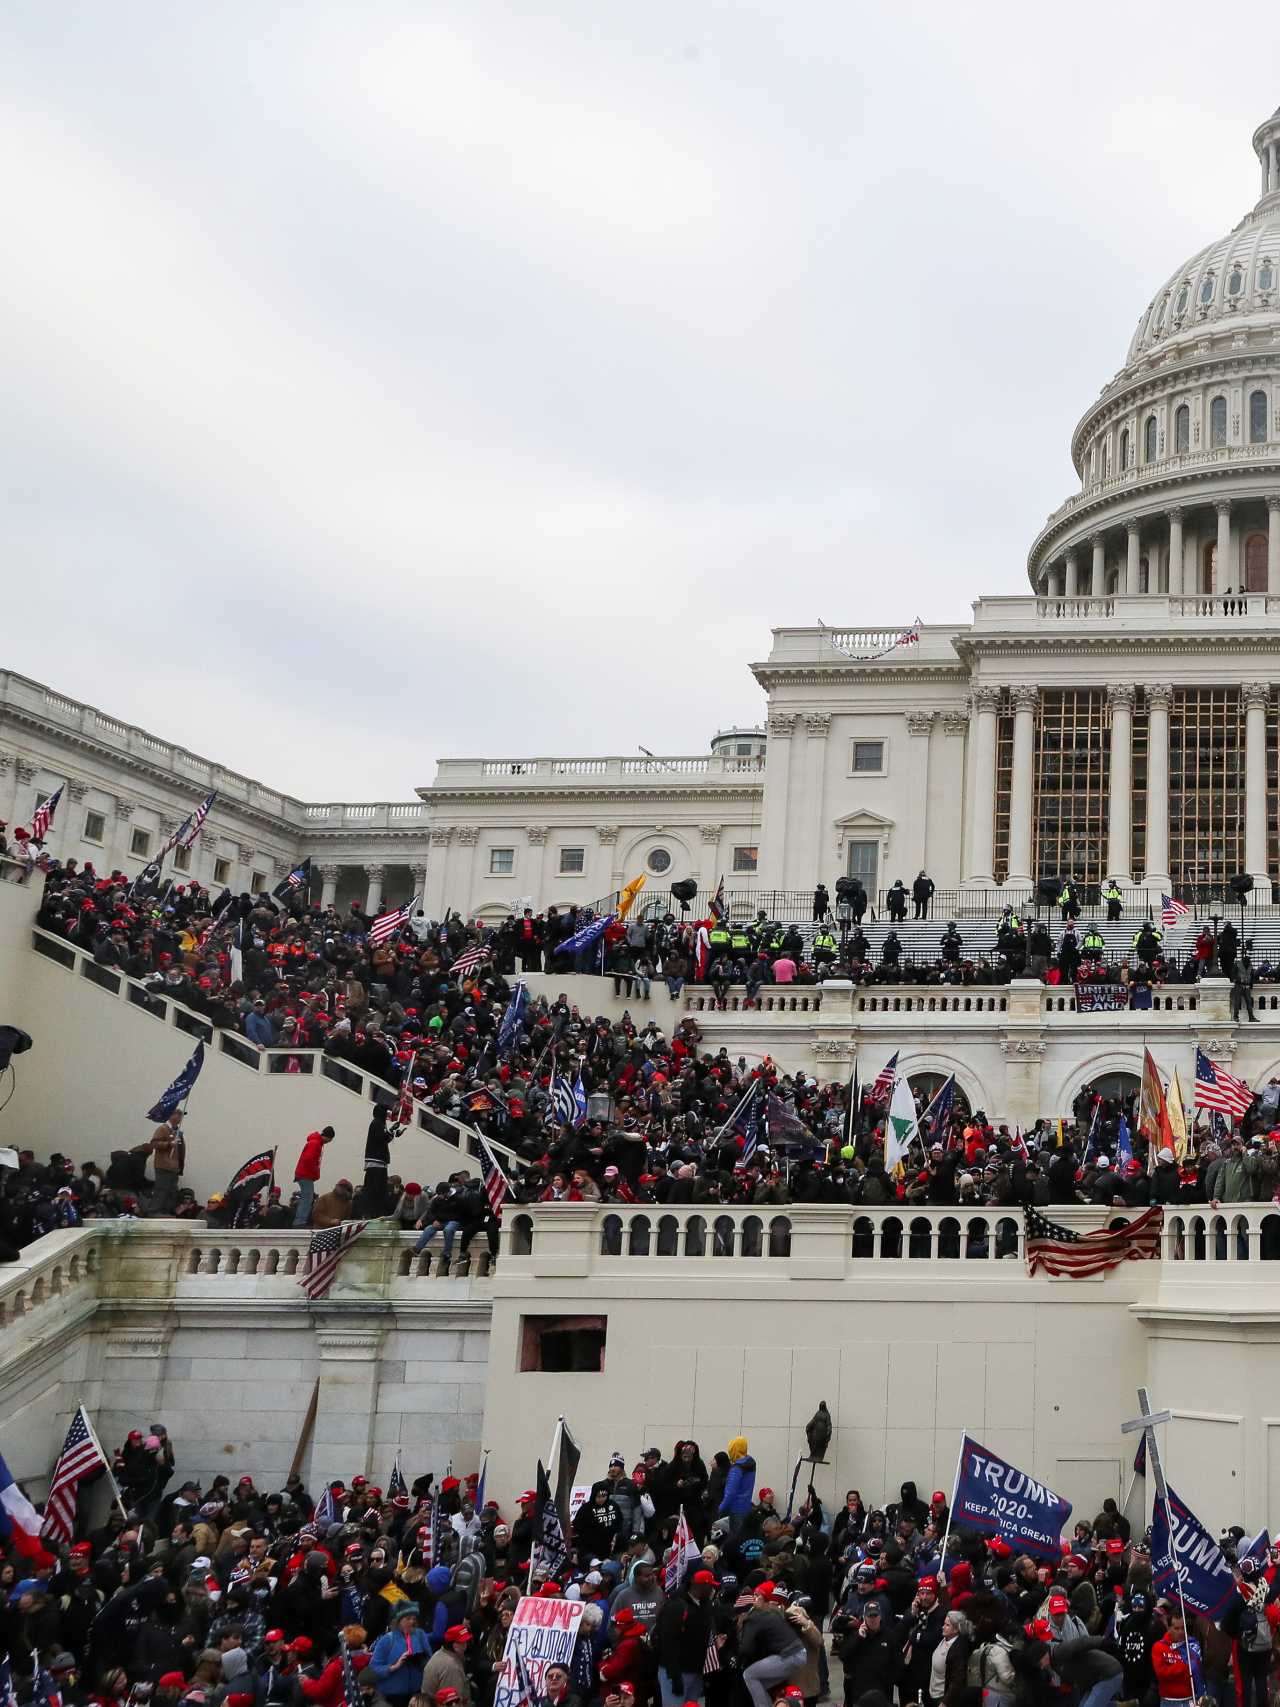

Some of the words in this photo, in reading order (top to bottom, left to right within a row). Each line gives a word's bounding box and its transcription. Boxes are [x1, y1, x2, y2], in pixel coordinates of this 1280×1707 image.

[1079, 986, 1127, 995] UNITED
[1093, 993, 1114, 1002] WE
[971, 1453, 1059, 1508] TRUMP
[964, 1501, 988, 1513] KEEP
[632, 1602, 657, 1611] TRUMP
[517, 1597, 583, 1630] TRUMP
